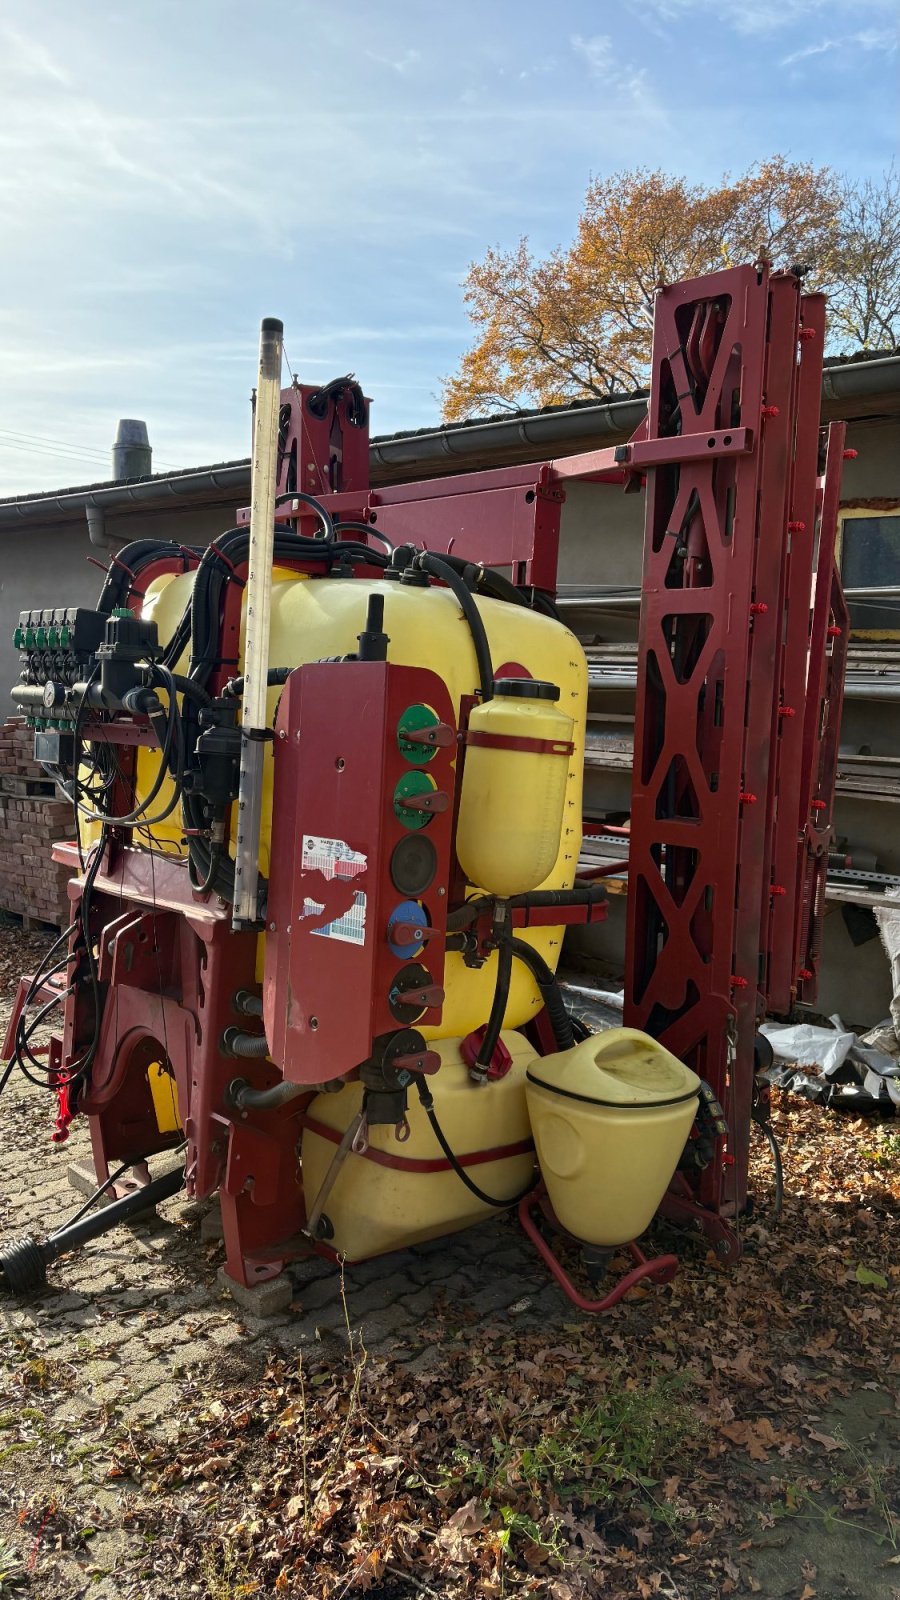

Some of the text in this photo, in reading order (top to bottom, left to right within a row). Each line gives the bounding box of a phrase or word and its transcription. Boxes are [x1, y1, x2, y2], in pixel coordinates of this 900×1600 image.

[239, 802, 245, 811] 12
[238, 835, 244, 844] 13
[236, 867, 242, 876] 14
[234, 904, 240, 913] 15
